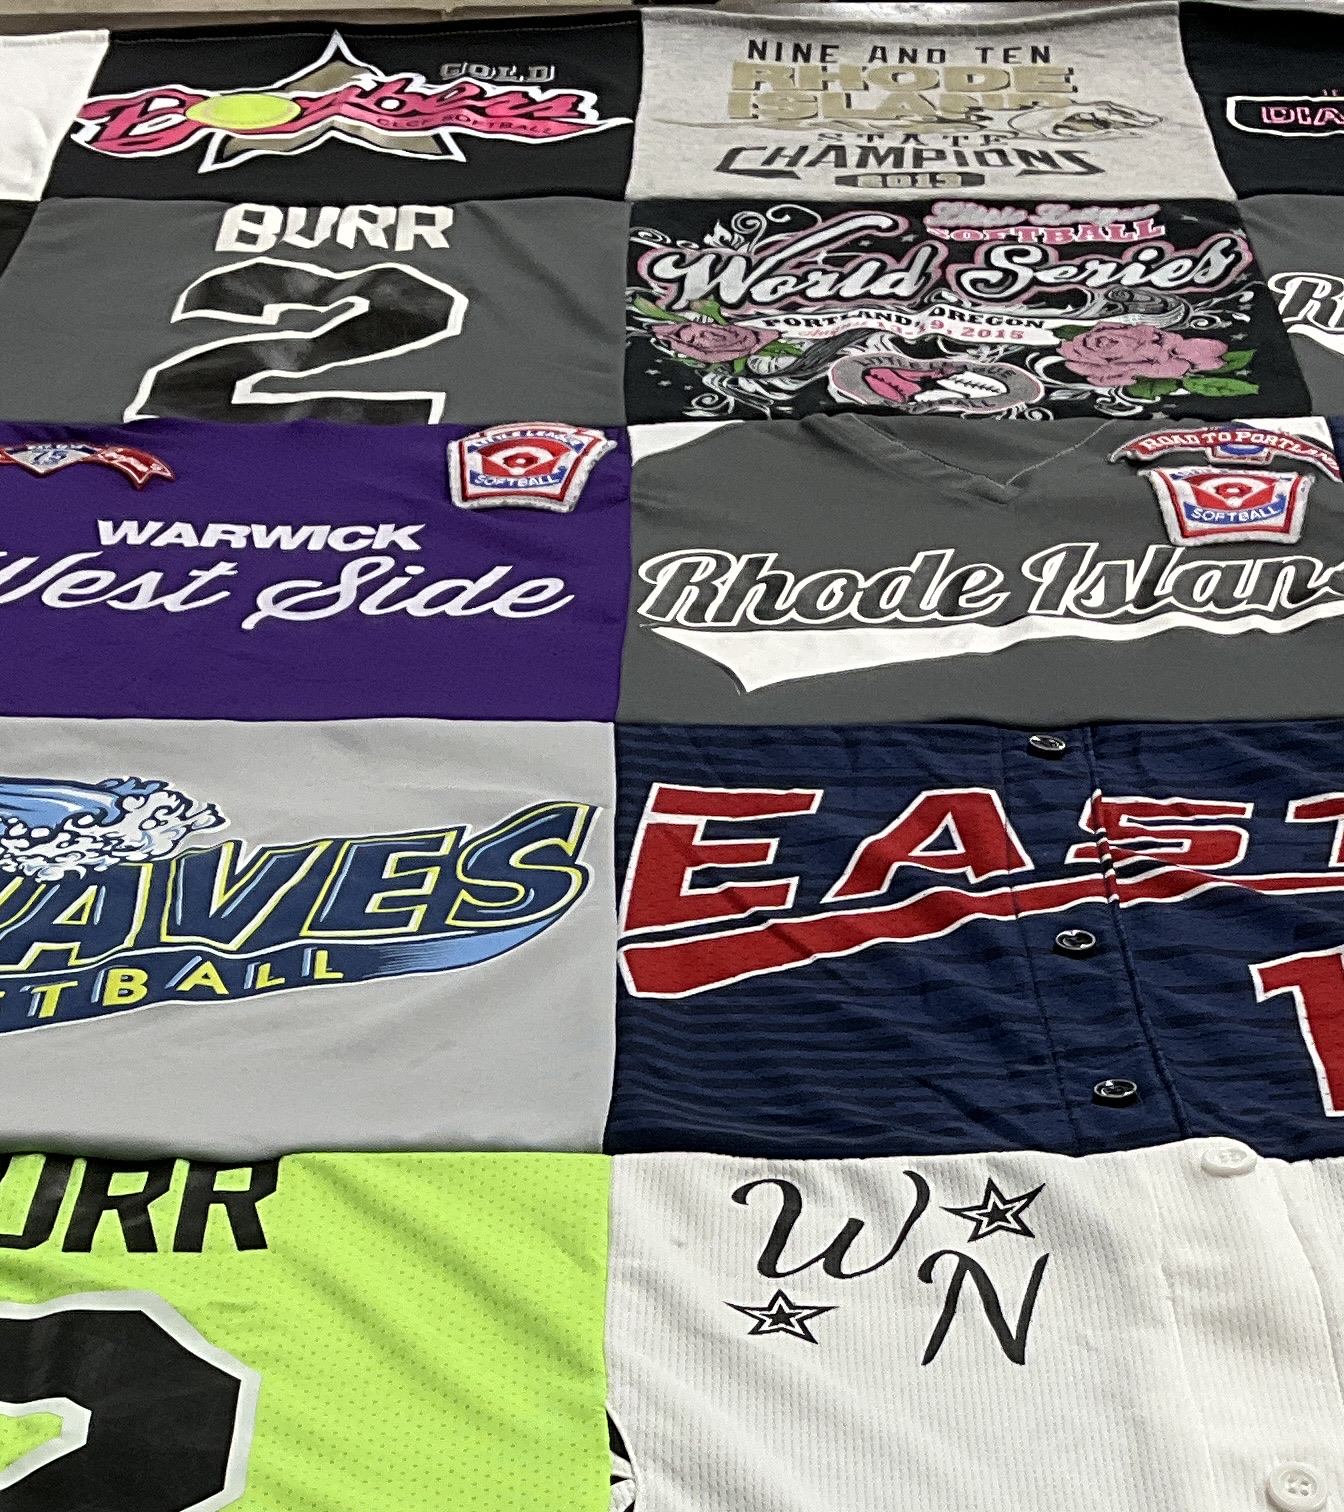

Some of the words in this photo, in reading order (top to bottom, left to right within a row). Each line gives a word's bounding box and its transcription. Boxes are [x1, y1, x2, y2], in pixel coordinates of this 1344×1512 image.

[748, 39, 841, 64] NINE
[869, 46, 947, 64] AND
[975, 46, 1052, 64] TEN
[440, 63, 555, 82] GOLD
[731, 62, 1078, 93] RHODE
[713, 144, 1106, 180] CHAMPIONS
[214, 203, 455, 252] BURR
[644, 212, 943, 306] World
[956, 235, 1248, 299] Series
[928, 307, 1046, 328] OREGON
[960, 327, 1025, 341] 2015
[123, 256, 470, 425] 2
[1139, 431, 1199, 451] ROAD
[1203, 431, 1227, 444] TO
[1234, 431, 1341, 471] PORTLAND
[474, 475, 561, 487] SOFTBALL
[1190, 506, 1282, 522] SOFTBALL
[97, 519, 426, 552] WARWICK
[241, 555, 576, 631] Side
[638, 547, 1012, 626] Rhode
